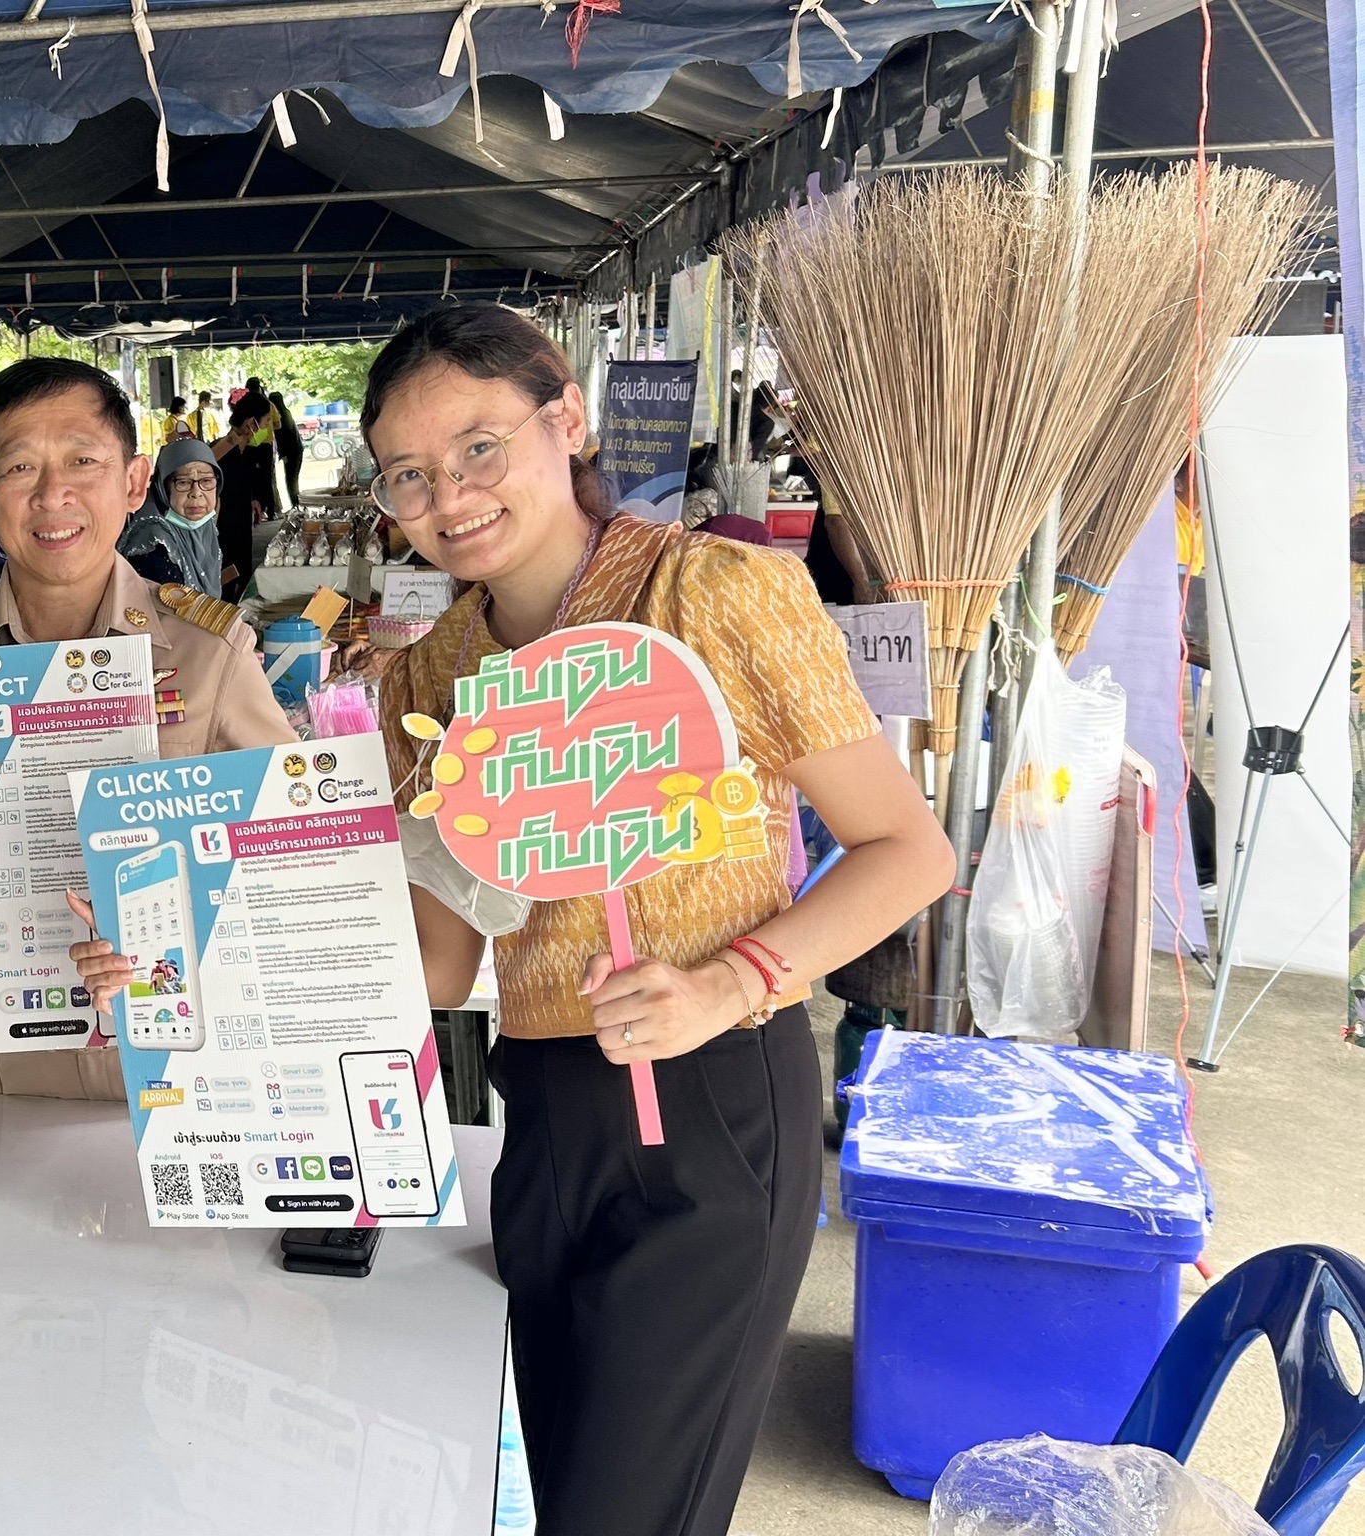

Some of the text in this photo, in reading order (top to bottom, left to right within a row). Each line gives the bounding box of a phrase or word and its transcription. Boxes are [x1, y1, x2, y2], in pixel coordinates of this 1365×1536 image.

[610, 376, 691, 407] กลุ่มสัมมาชีพ
[861, 635, 912, 663] บาท
[456, 634, 651, 727] เก็บเงิน
[17, 699, 128, 717] แอปพลิเคชัน คลิกชุมชน
[19, 716, 110, 734] มีเมนูบริการมากกว่า
[112, 714, 125, 725] 13
[483, 714, 679, 809] เก็บเงิน
[97, 769, 172, 799] CLICK
[175, 765, 213, 790] TO
[339, 787, 378, 800] for Good
[120, 789, 245, 824] CONNECT
[234, 812, 363, 838] แอปพลิเคชัน คลิกชุมชน
[99, 831, 149, 848] คลิกชุมชน
[238, 834, 343, 857] มีเมนูบริการมากกว่า
[344, 831, 361, 844] 13
[363, 828, 386, 845] เมนู
[497, 798, 694, 890] เก็บเงิน
[30, 965, 60, 978] Login
[144, 1091, 182, 1103] ARRIVAL
[173, 1129, 315, 1147] เข้าสู่ระบบด้วย Smart Login
[154, 1153, 182, 1161] Android
[287, 1200, 301, 1209] Sign
[322, 1199, 341, 1208] Apple
[166, 1212, 200, 1220] Play Store
[216, 1212, 250, 1220] App Store
